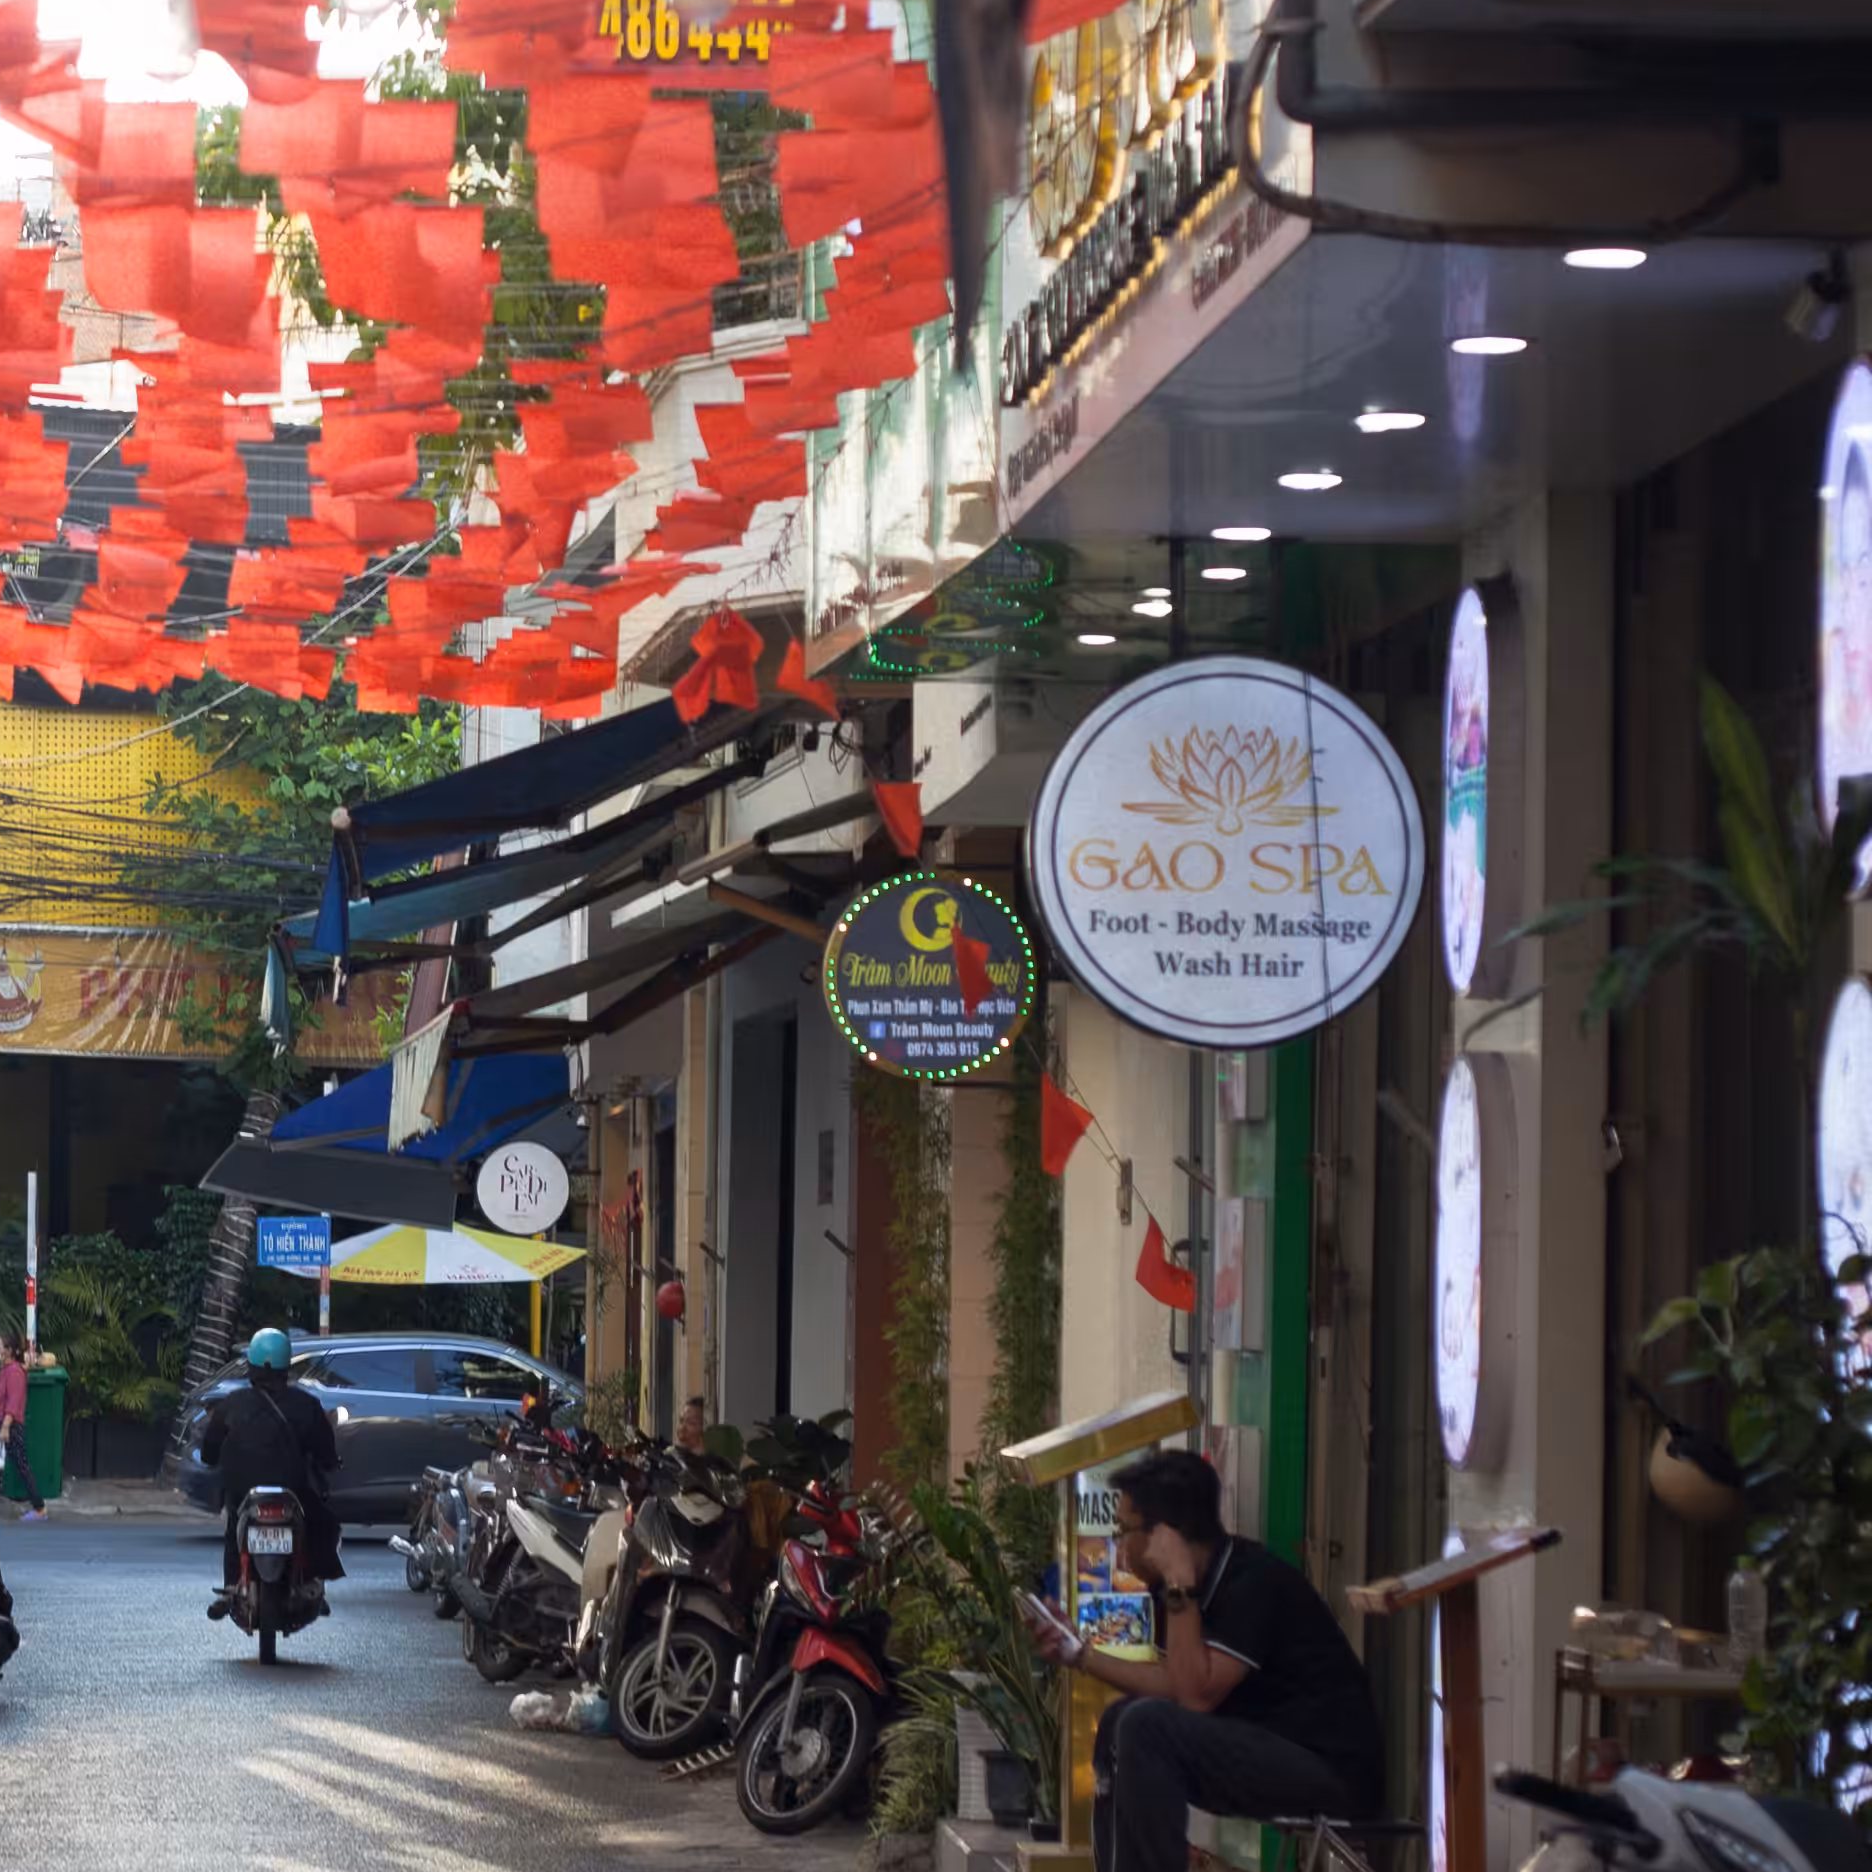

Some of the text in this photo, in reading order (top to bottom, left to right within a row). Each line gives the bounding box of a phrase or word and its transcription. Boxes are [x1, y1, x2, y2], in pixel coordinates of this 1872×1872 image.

[1068, 837, 1392, 896] GAO SPA
[1089, 909, 1150, 935] Foot
[1178, 911, 1246, 942] Body
[1254, 913, 1371, 944] Massage
[895, 953, 951, 988] Moon
[1154, 951, 1305, 978] Wash Hair
[922, 1022, 954, 1037] Moon
[956, 1022, 995, 1038] Beauty
[1075, 1491, 1120, 1525] MASS
